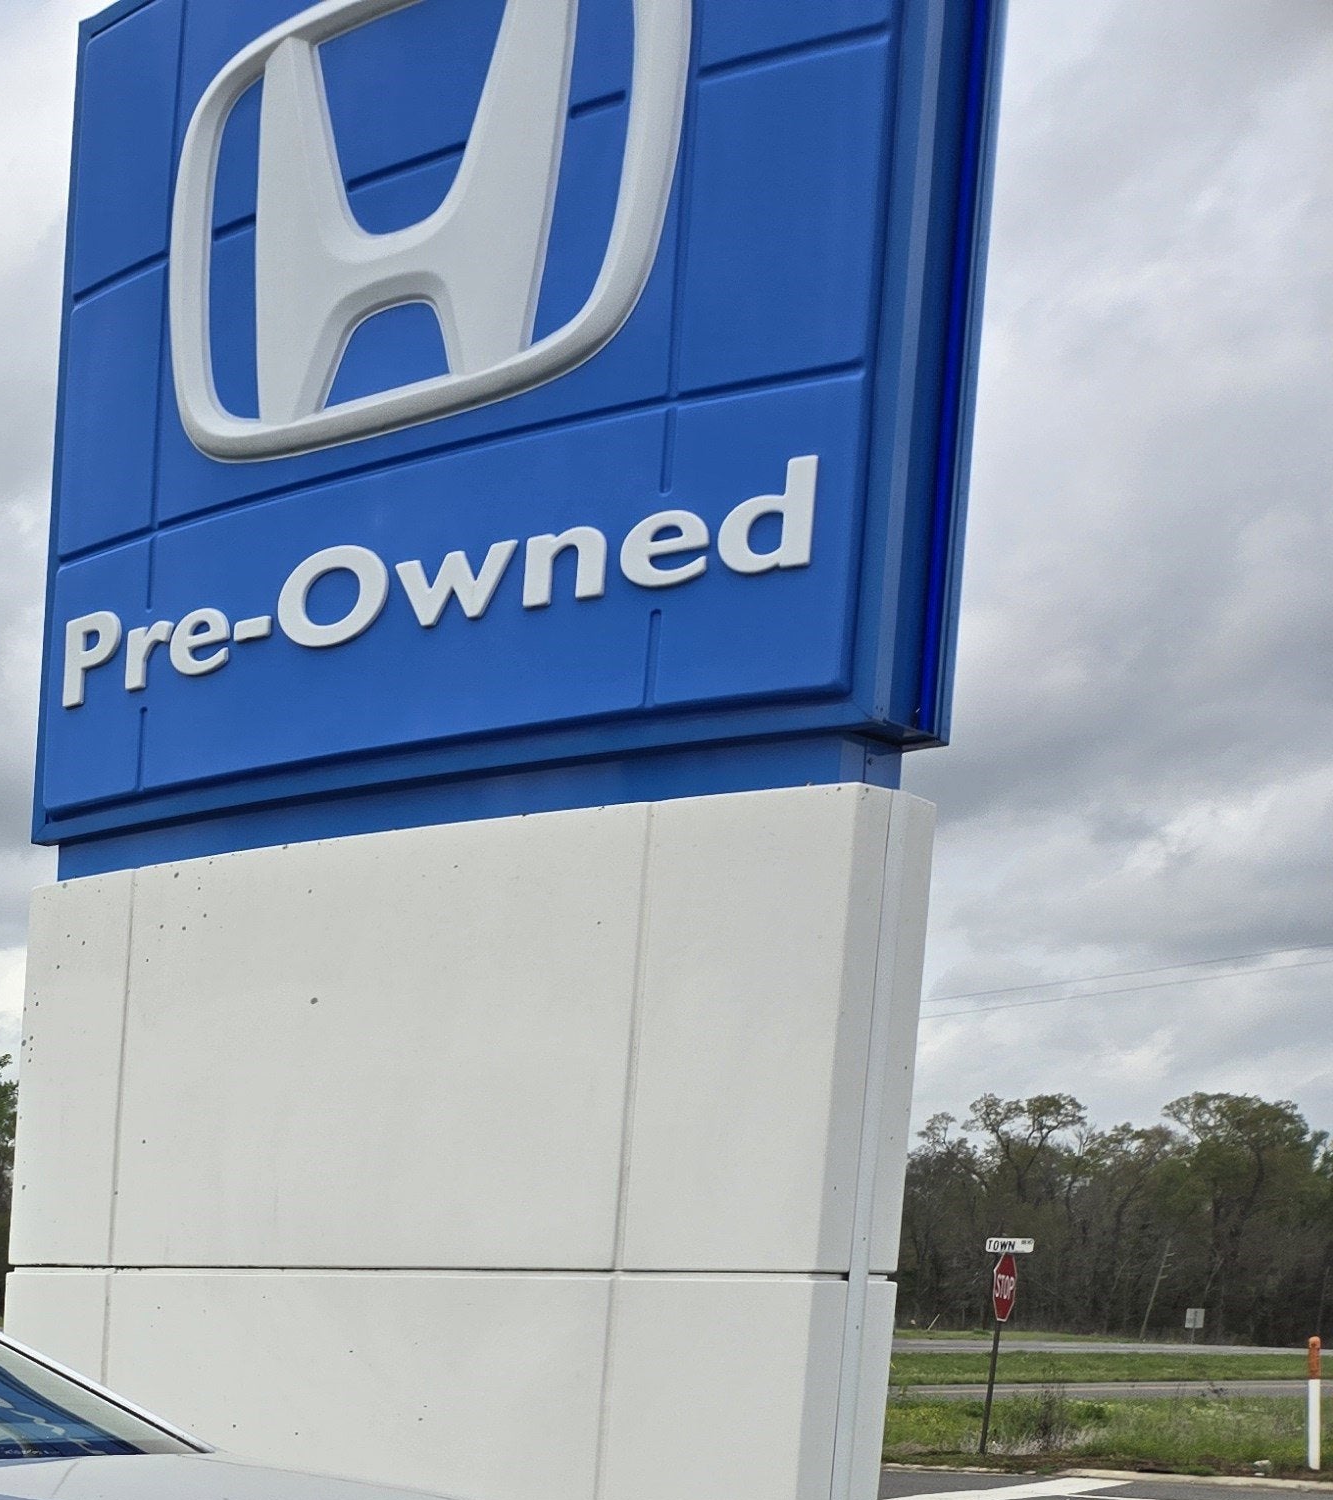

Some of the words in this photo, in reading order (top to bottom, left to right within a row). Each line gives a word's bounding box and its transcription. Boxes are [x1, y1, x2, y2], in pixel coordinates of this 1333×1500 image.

[61, 453, 820, 708] Pre-Owned
[987, 1239, 1015, 1251] TOWN
[995, 1273, 1015, 1300] STOP
